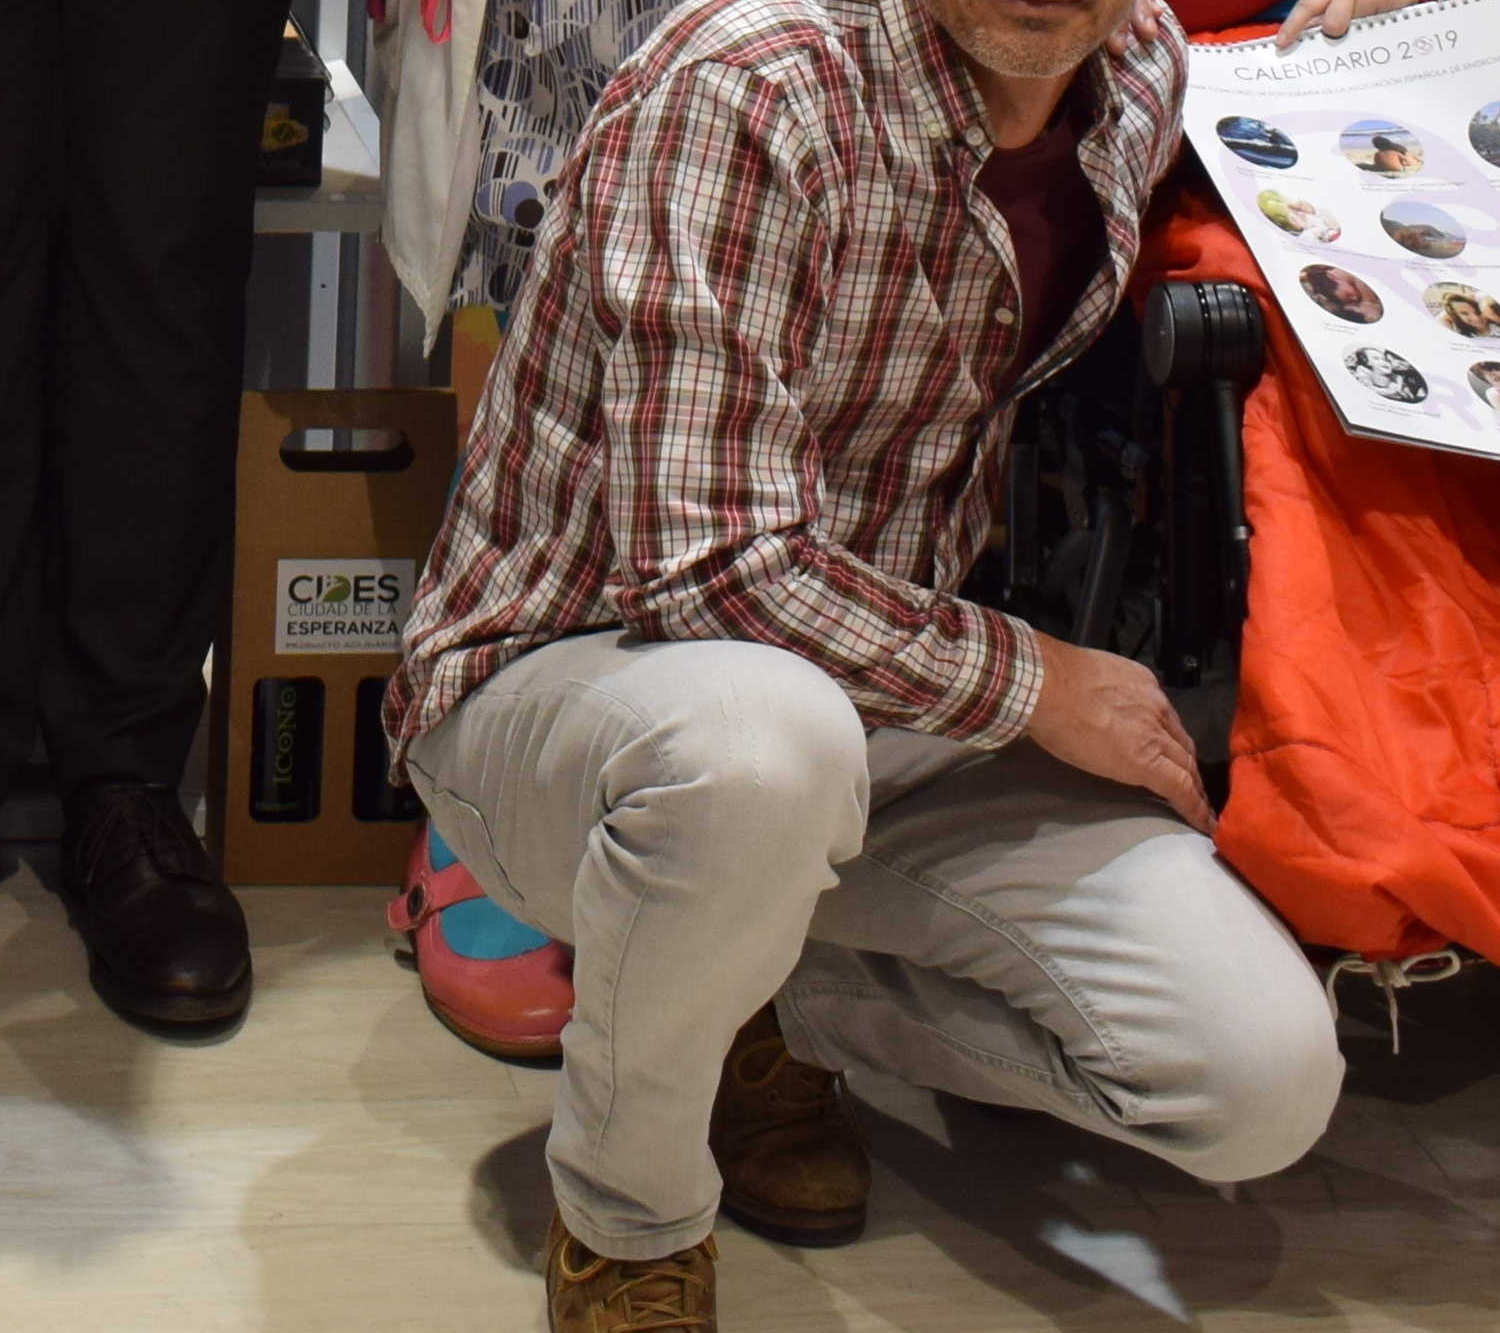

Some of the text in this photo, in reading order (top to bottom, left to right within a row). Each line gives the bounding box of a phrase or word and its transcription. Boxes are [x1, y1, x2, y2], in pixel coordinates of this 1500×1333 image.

[1233, 44, 1391, 83] CALENDARIO
[287, 602, 398, 617] CIUDAD DE LA
[286, 619, 400, 637] ESPERANZA
[272, 685, 298, 786] ICONO
